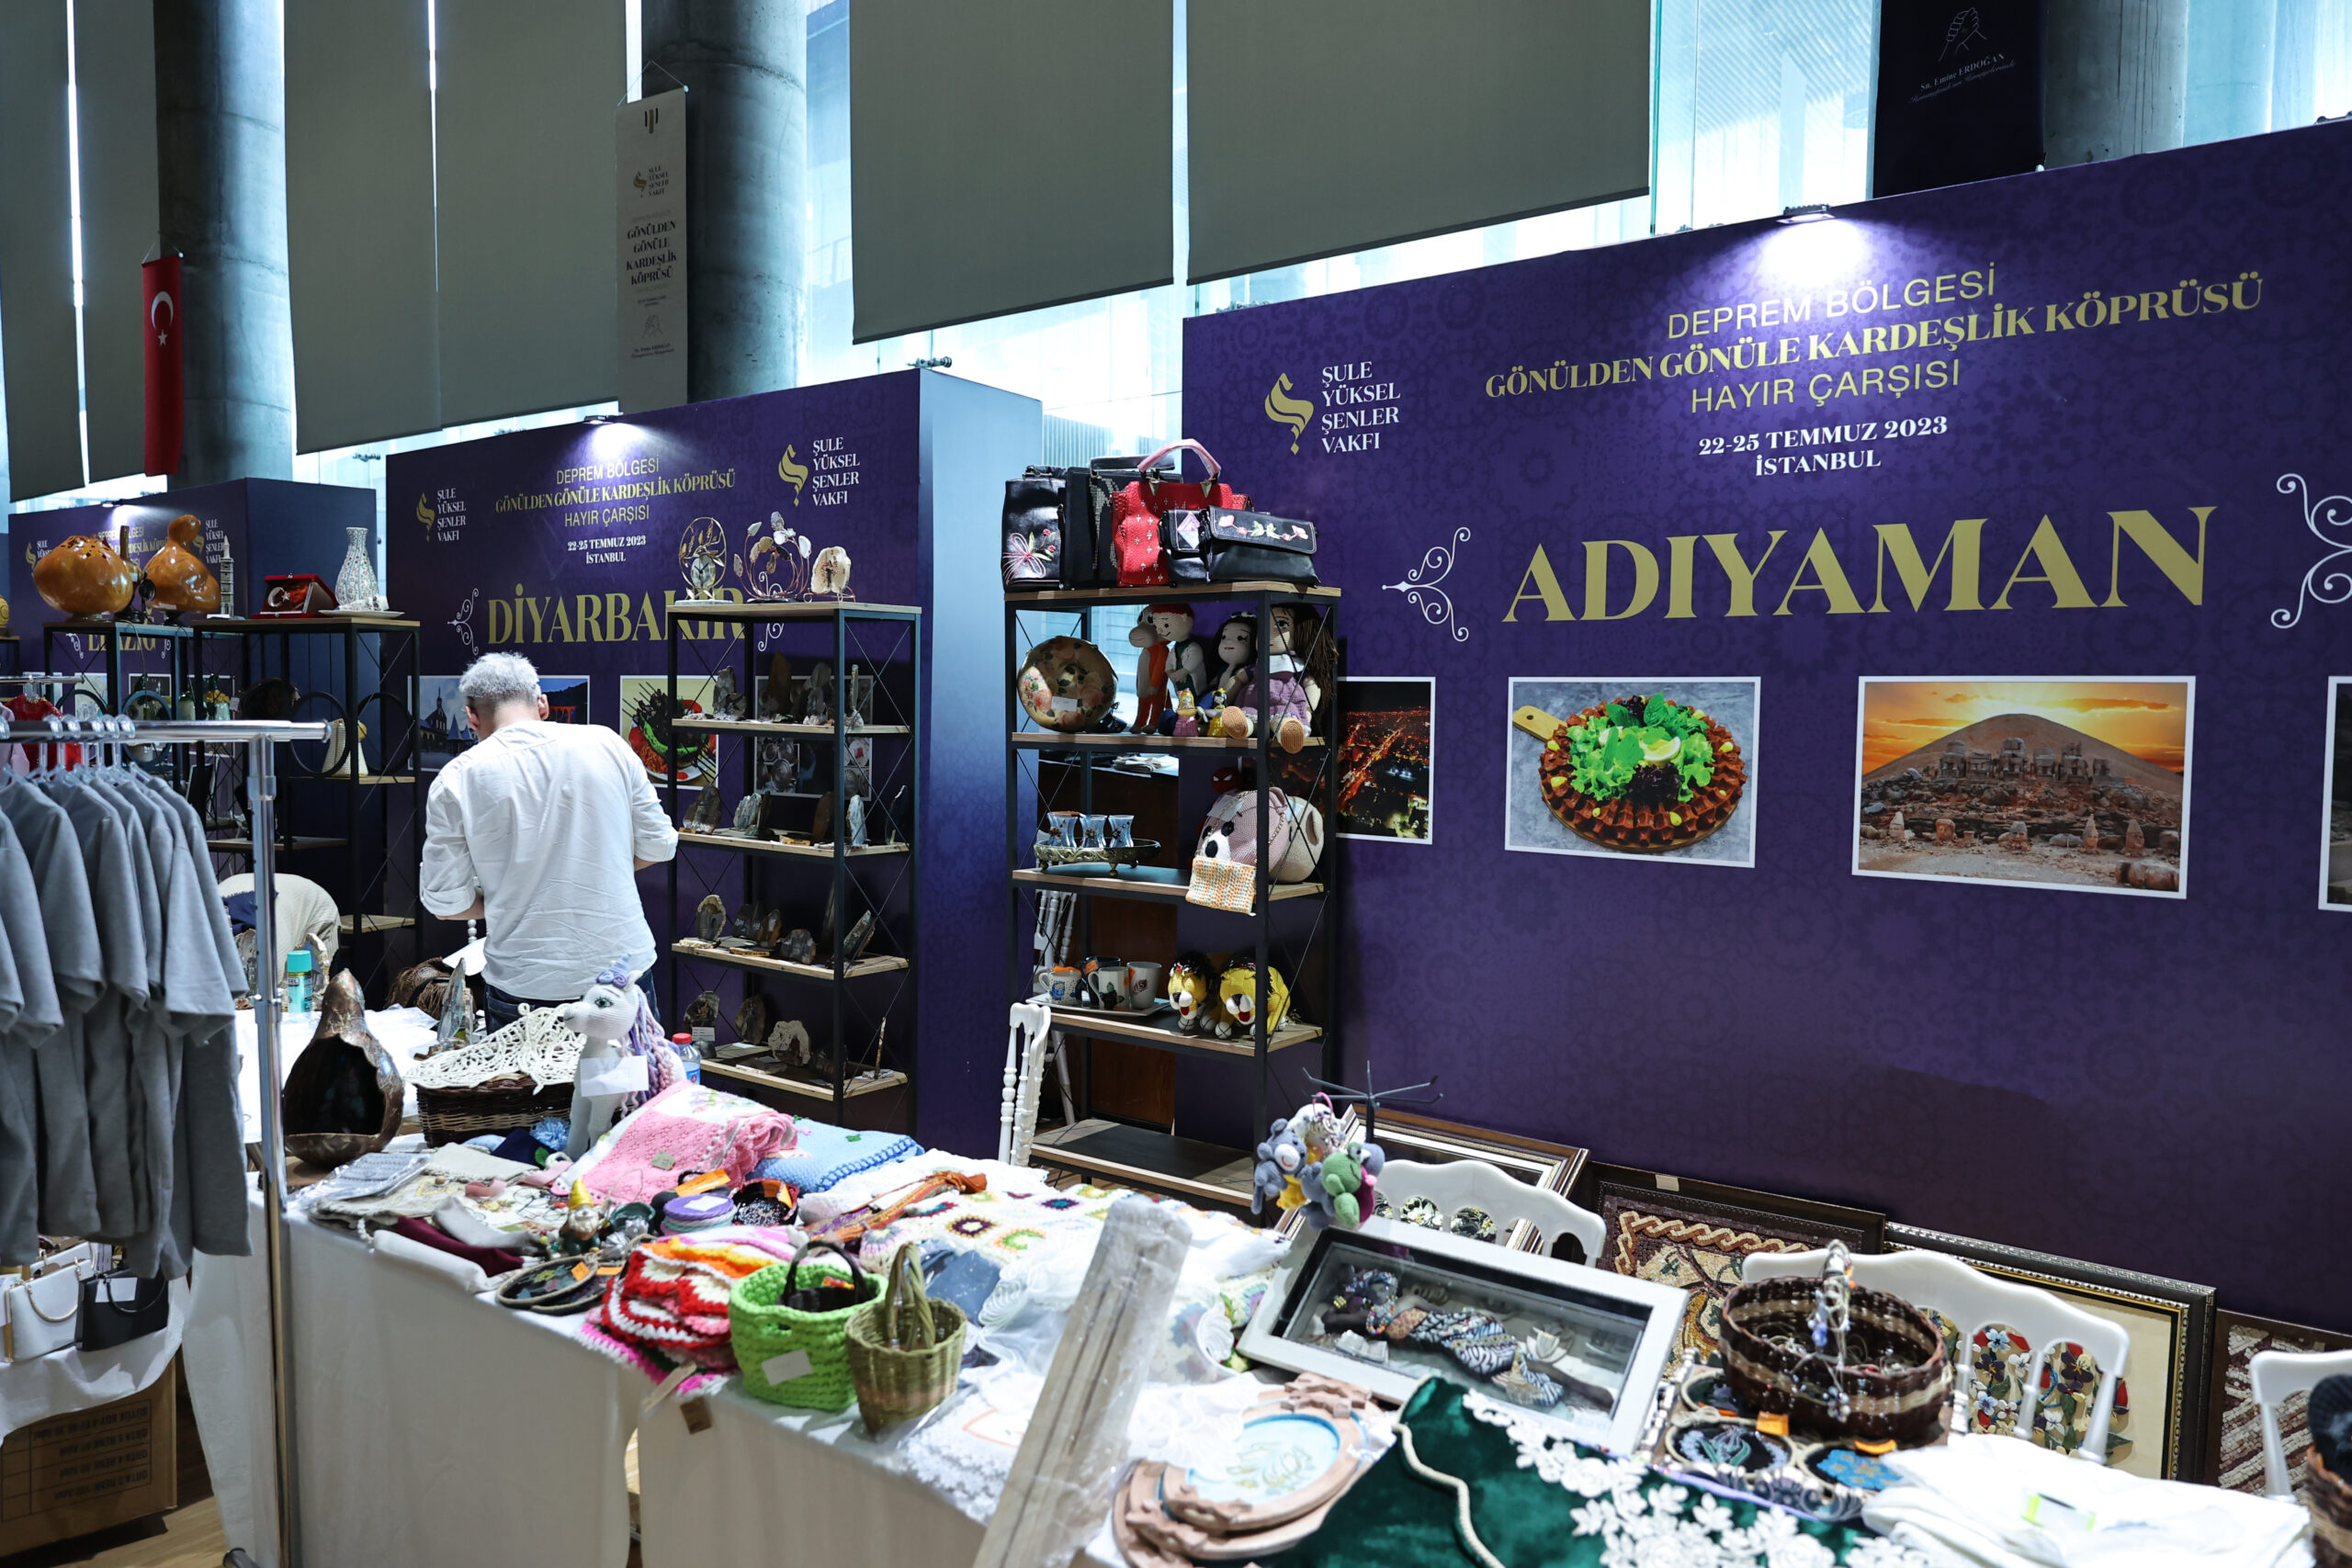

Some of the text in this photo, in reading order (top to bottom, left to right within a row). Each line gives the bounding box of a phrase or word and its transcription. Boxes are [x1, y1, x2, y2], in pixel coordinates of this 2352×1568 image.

[628, 220, 675, 239] GÖNÜLDEN
[634, 237, 669, 253] GÖNÜLE
[1668, 261, 1995, 339] DEPREM BÖLGESİ
[1486, 270, 2263, 398] GÖNÜLDEN GÖNÜLE KARDEŞLİK KÖPRÜSÜ
[1321, 361, 1373, 388] ŞULE
[1321, 382, 1401, 407] YÜKSEL
[1690, 358, 1960, 414] HAYIR ÇARŞISI
[1321, 406, 1399, 435] ŞENLER
[812, 436, 843, 457] ŞULE
[1321, 432, 1381, 454] VAKFI
[1698, 416, 1948, 456] 22-25 TEMMUZ 2023
[556, 454, 660, 485] DEPREM BÖLGESİ
[812, 454, 861, 471] YÜKSEL
[1755, 449, 1882, 477] İSTANBUL
[495, 468, 736, 513] GÖNÜLDEN GÖNÜLE KARDEŞLİK KÖPRÜSÜ
[812, 471, 859, 491] ŞENLER
[436, 488, 457, 503] ŞULE
[812, 491, 848, 506] VAKFI
[436, 501, 467, 514] YÜKSEL
[564, 504, 650, 527] HAYIR ÇARŞISI
[436, 515, 467, 531] ŞENLER
[436, 530, 459, 542] VAKFI
[567, 535, 647, 552] 22-25 TEMMUZ 2023
[586, 551, 627, 565] İSTANBUL
[1501, 506, 2218, 623] ADIYAMAN
